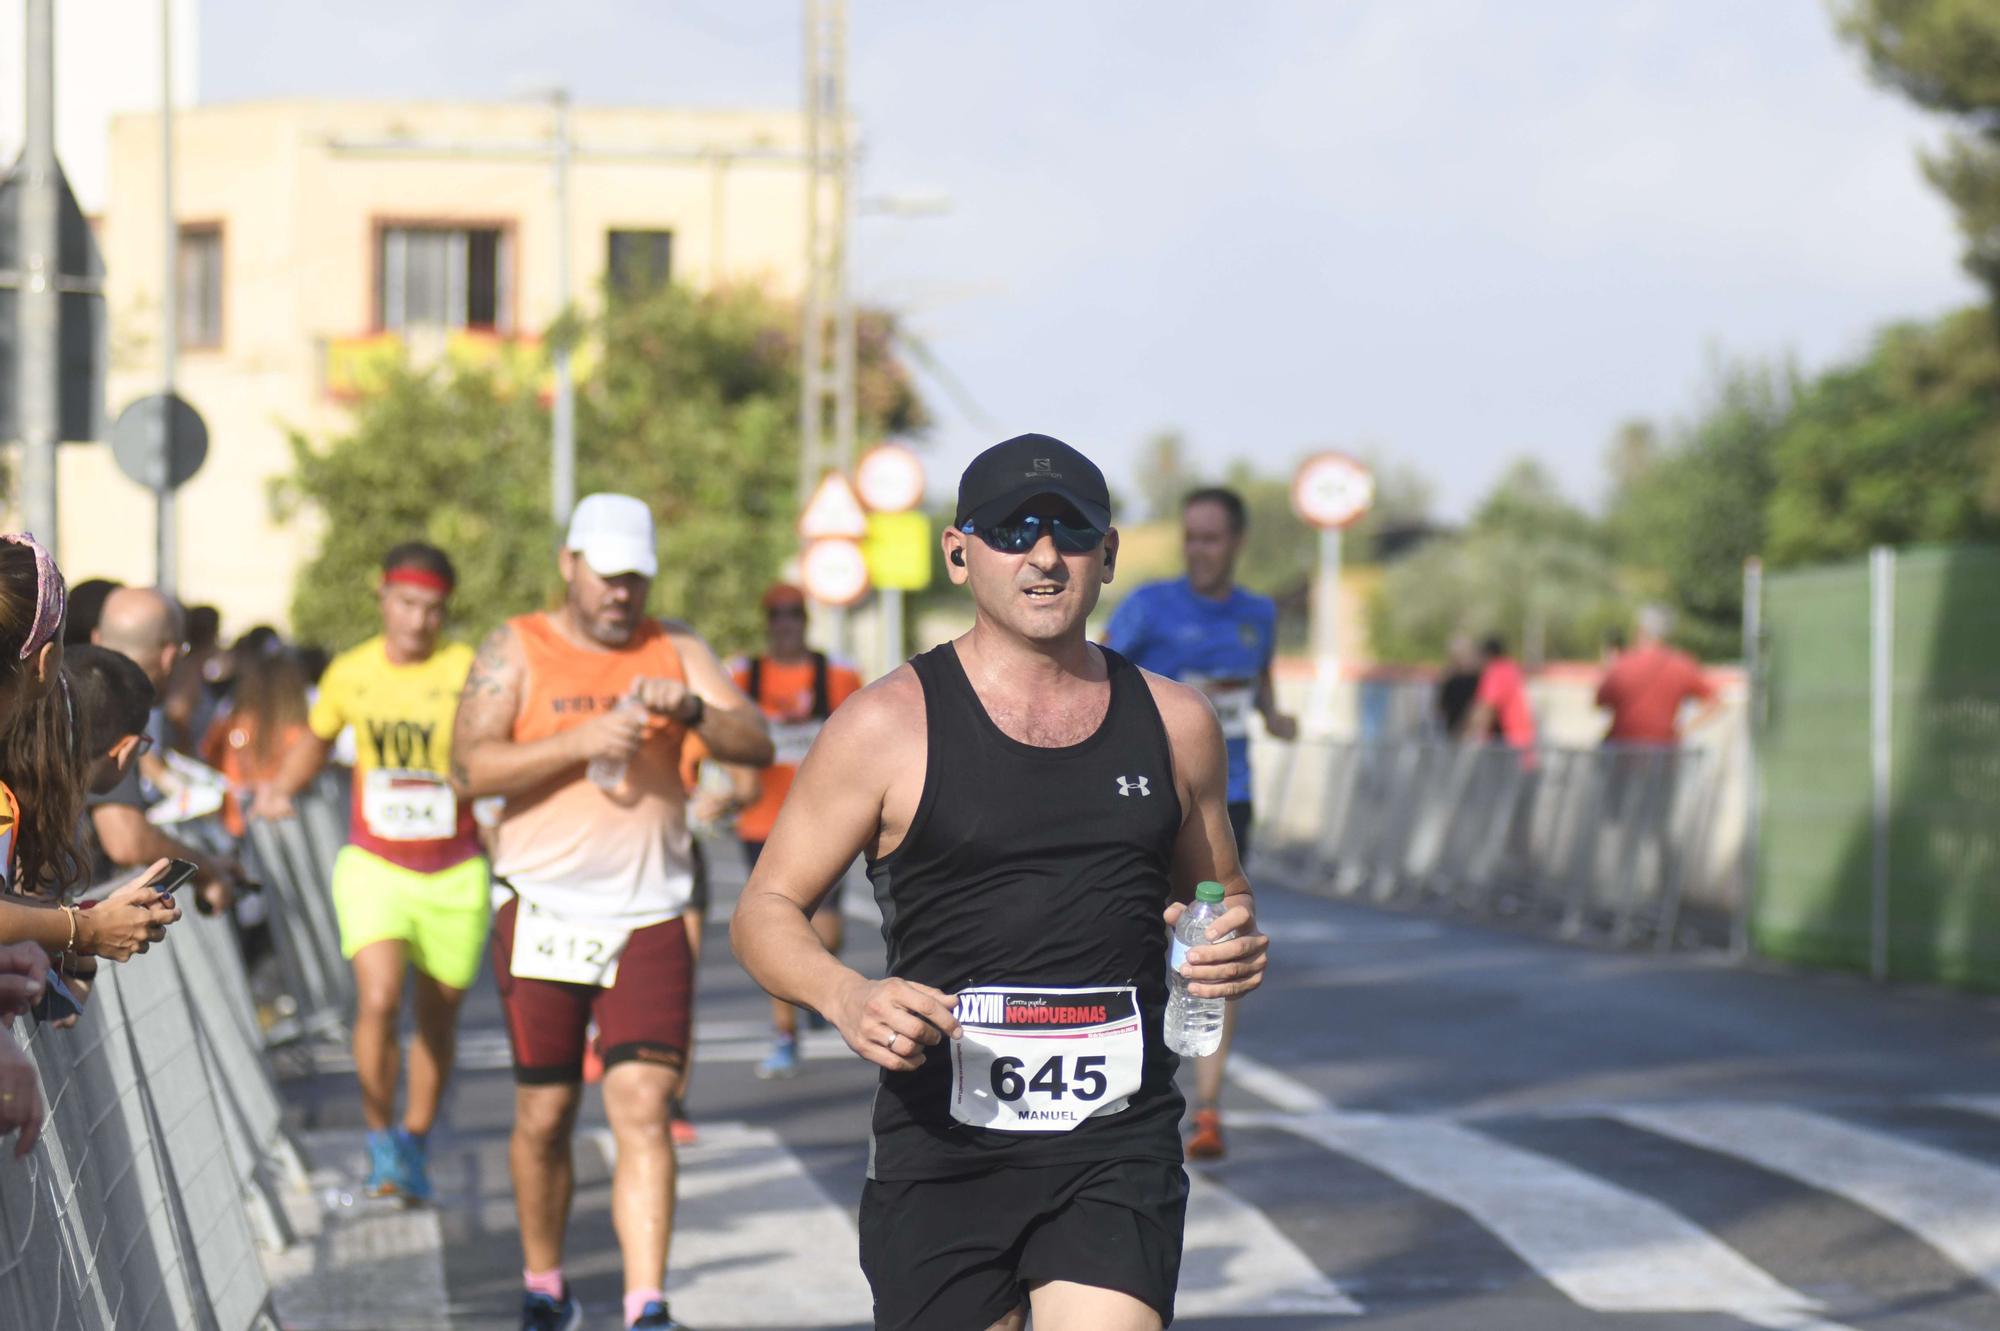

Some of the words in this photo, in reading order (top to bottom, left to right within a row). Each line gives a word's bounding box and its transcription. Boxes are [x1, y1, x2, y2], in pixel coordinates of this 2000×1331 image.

[536, 936, 607, 967] 412
[953, 993, 1004, 1024] XXVIII
[1005, 1006, 1107, 1024] NONDUERMAS
[990, 1055, 1108, 1102] 645
[1018, 1111, 1078, 1121] MANUEL
